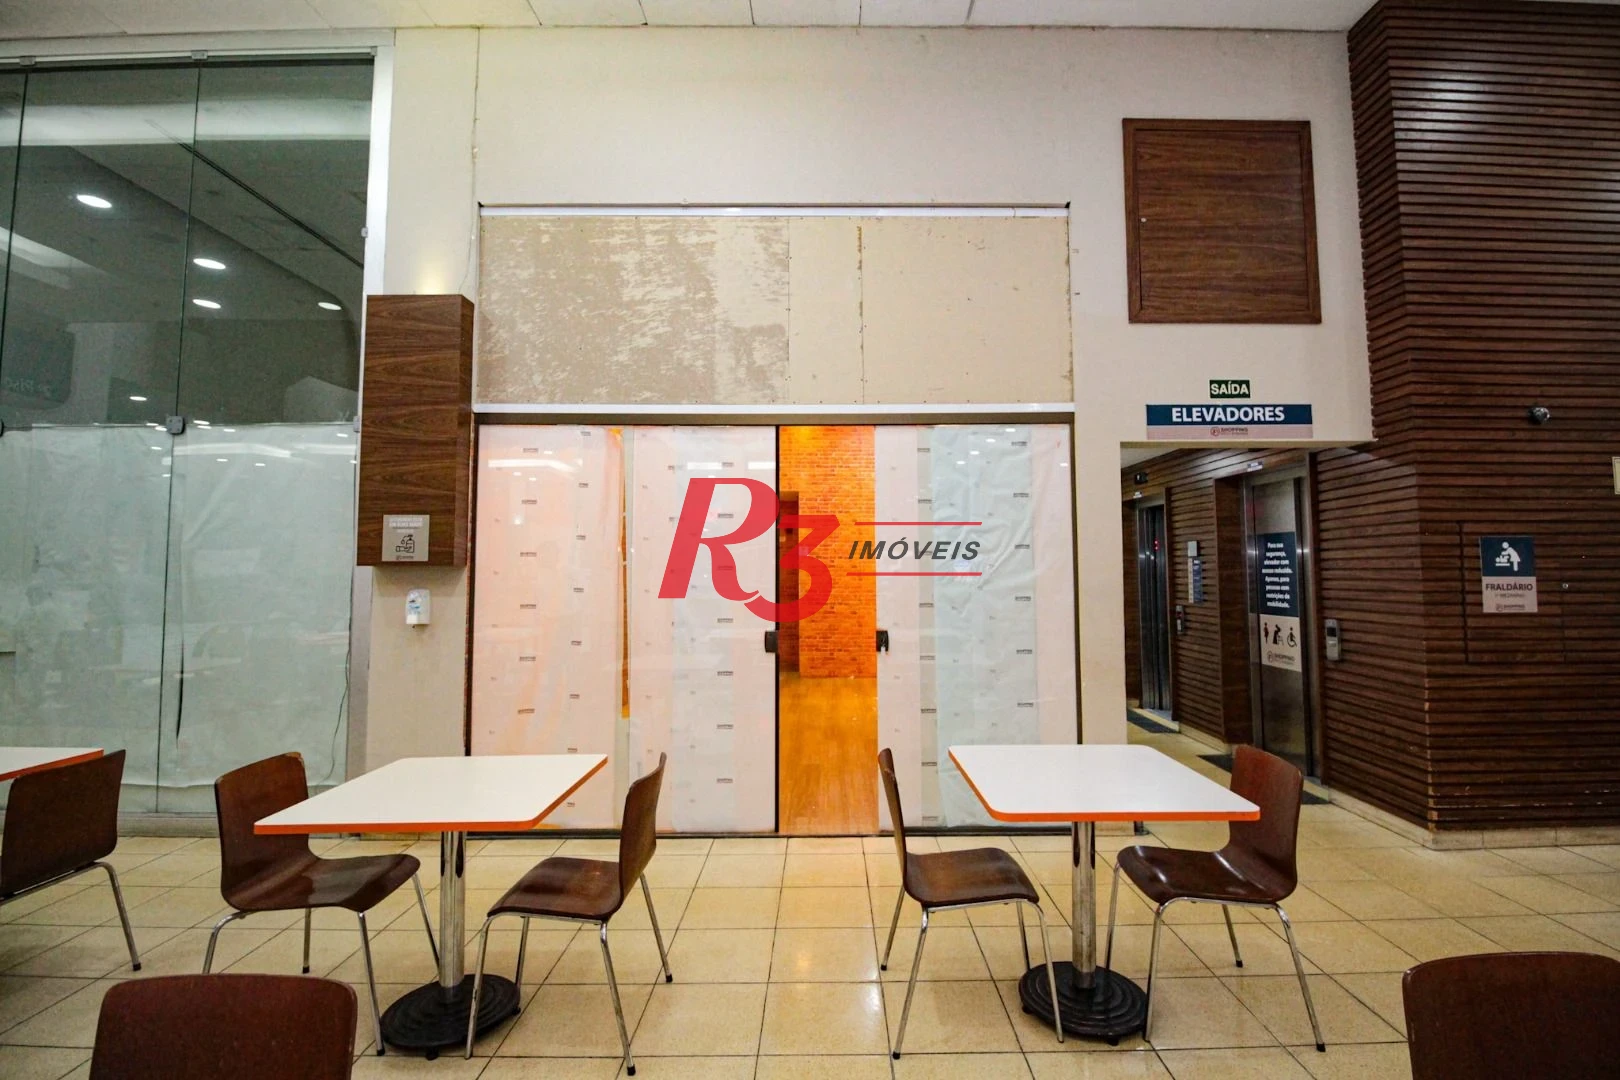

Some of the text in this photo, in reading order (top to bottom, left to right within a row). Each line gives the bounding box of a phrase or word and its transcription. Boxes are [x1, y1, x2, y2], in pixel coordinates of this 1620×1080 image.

[1211, 381, 1249, 395] SAÍDA
[1172, 407, 1285, 422] ELEVADORES
[1486, 582, 1533, 591] FRALDÁRIO
